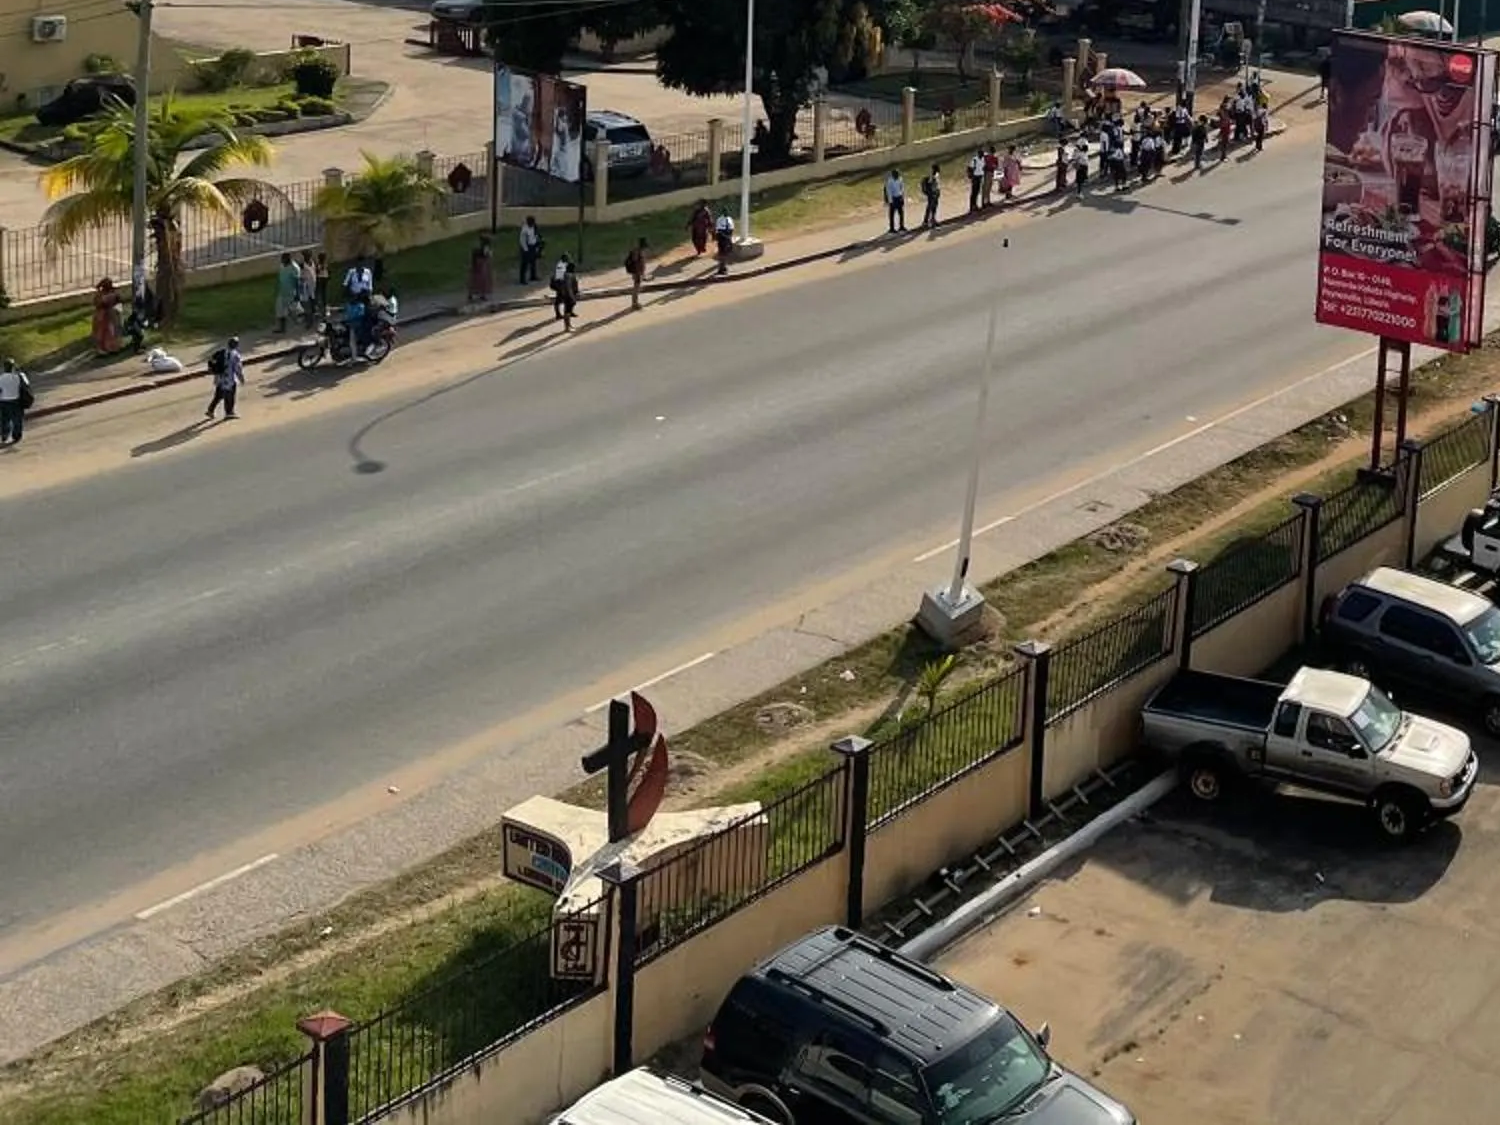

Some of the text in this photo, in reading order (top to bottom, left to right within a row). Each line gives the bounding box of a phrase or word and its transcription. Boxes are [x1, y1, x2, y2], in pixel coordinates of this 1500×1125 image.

[1326, 218, 1409, 244] Refreshment
[1325, 234, 1417, 261] For Everyone!
